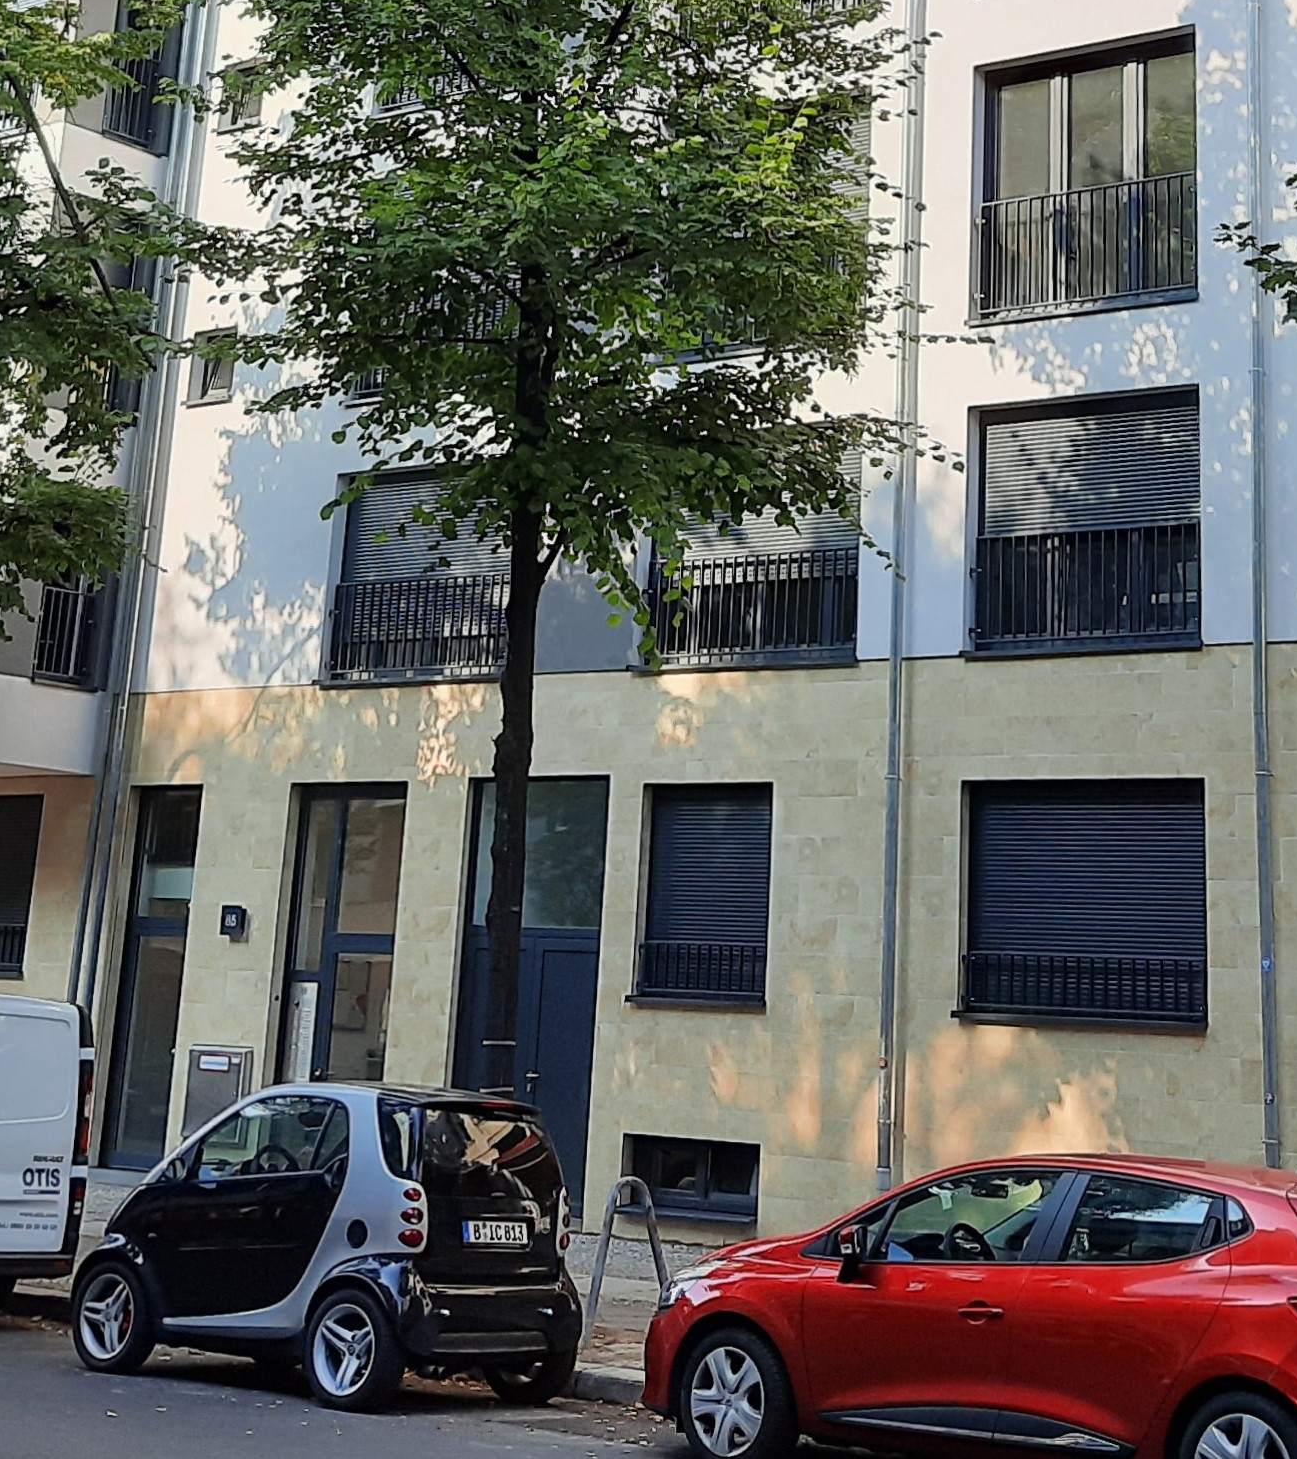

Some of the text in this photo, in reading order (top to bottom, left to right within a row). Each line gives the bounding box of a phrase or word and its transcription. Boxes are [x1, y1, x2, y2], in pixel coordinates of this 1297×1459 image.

[22, 1167, 61, 1188] OTIS
[473, 1223, 482, 1241] B
[504, 1225, 524, 1242] 813
